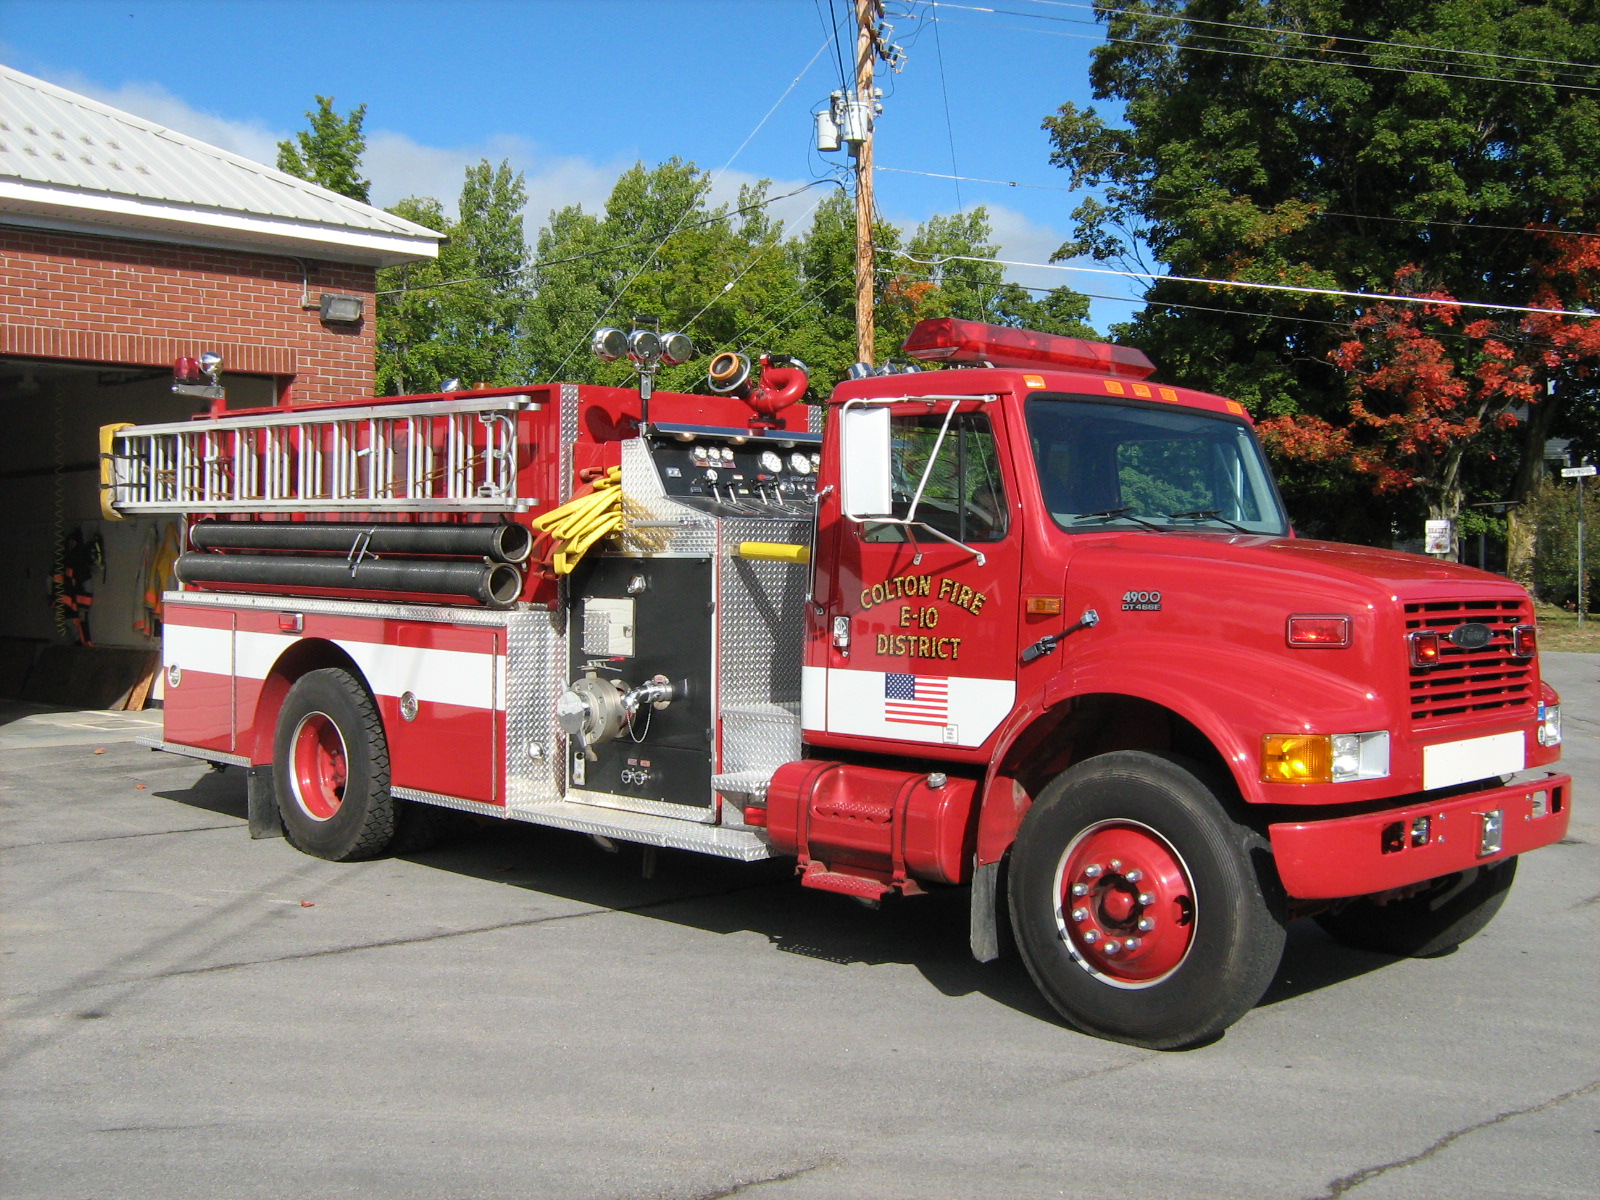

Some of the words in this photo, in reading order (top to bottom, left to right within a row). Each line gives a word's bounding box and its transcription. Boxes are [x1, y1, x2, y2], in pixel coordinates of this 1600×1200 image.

[860, 575, 932, 610] COLTON
[938, 578, 987, 616] FIRE
[1121, 590, 1162, 603] 4900
[899, 606, 939, 628] E-10
[876, 633, 961, 660] DISTRICT
